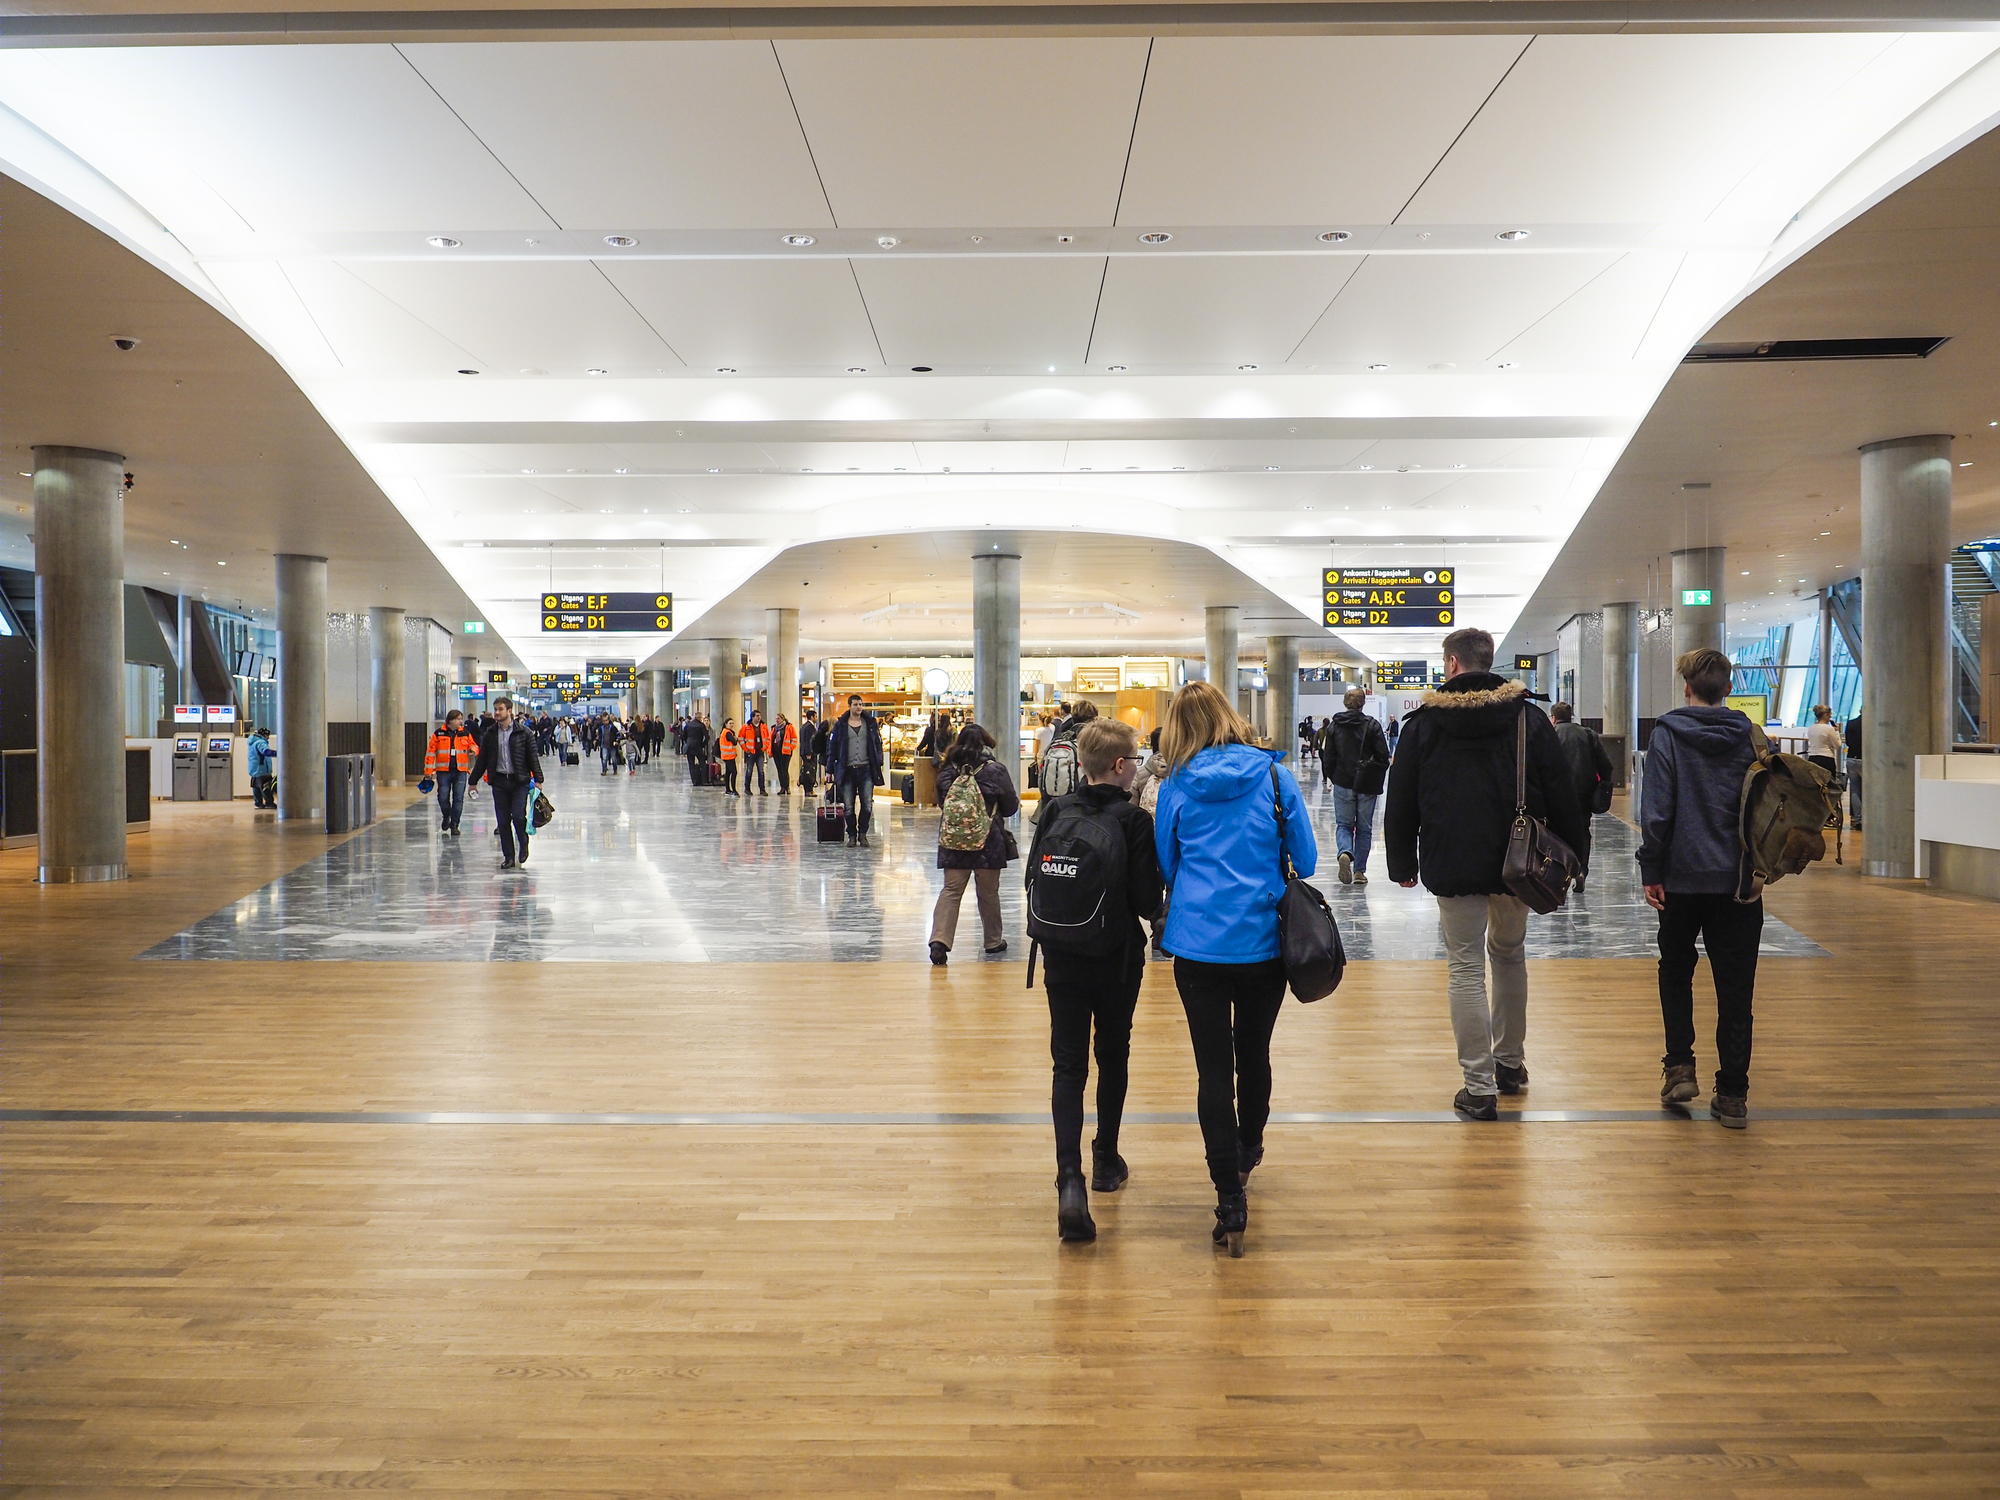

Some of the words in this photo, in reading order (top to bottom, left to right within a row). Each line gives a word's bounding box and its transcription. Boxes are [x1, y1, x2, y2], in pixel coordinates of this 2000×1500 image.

[1374, 570, 1410, 578] Bagasjehall
[1371, 577, 1398, 585] Baggage
[1343, 590, 1366, 598] Utgang
[561, 594, 584, 603] Utgang
[587, 595, 608, 610] E,F
[1369, 591, 1406, 606] A,B,C
[1343, 610, 1366, 618] Utgang
[1369, 611, 1389, 624] D2
[561, 615, 584, 623] Utgang
[587, 615, 606, 629] D1
[1520, 660, 1531, 668] D2
[1041, 862, 1079, 875] OAUG
